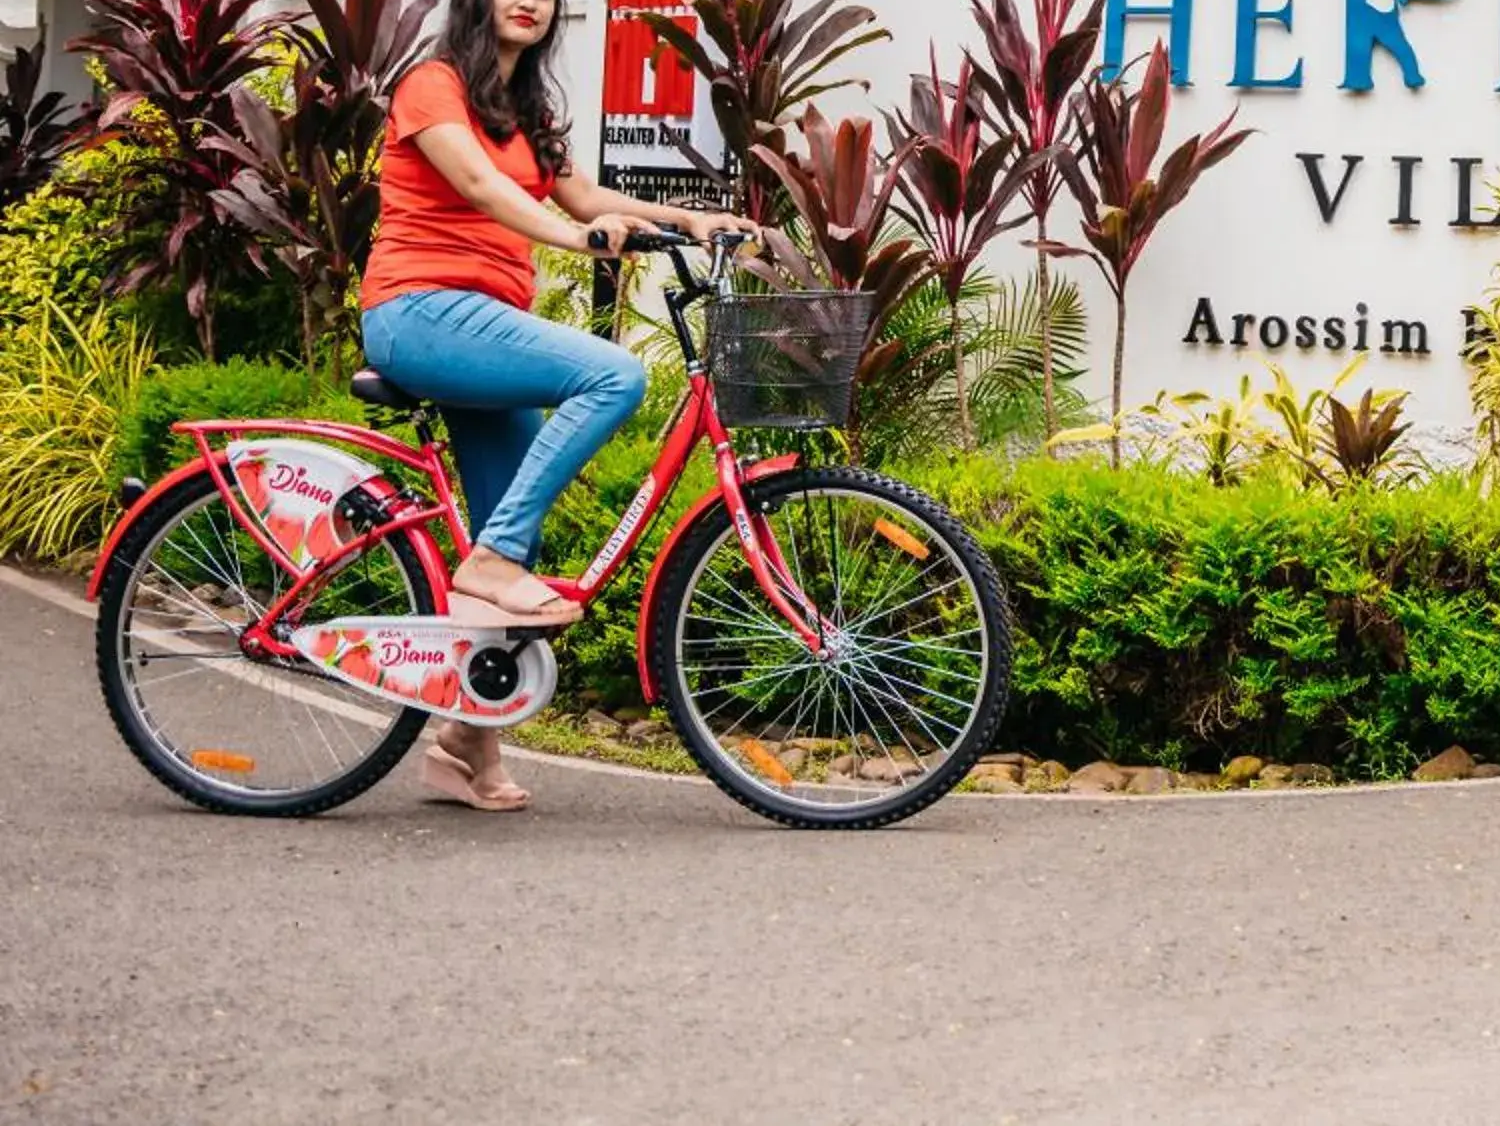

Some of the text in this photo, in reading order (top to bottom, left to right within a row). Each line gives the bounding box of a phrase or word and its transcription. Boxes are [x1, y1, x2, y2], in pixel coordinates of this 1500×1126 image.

[605, 126, 655, 146] ELEVATED
[1181, 297, 1432, 354] Arossim
[269, 463, 334, 506] Diana
[379, 639, 445, 667] Diana
